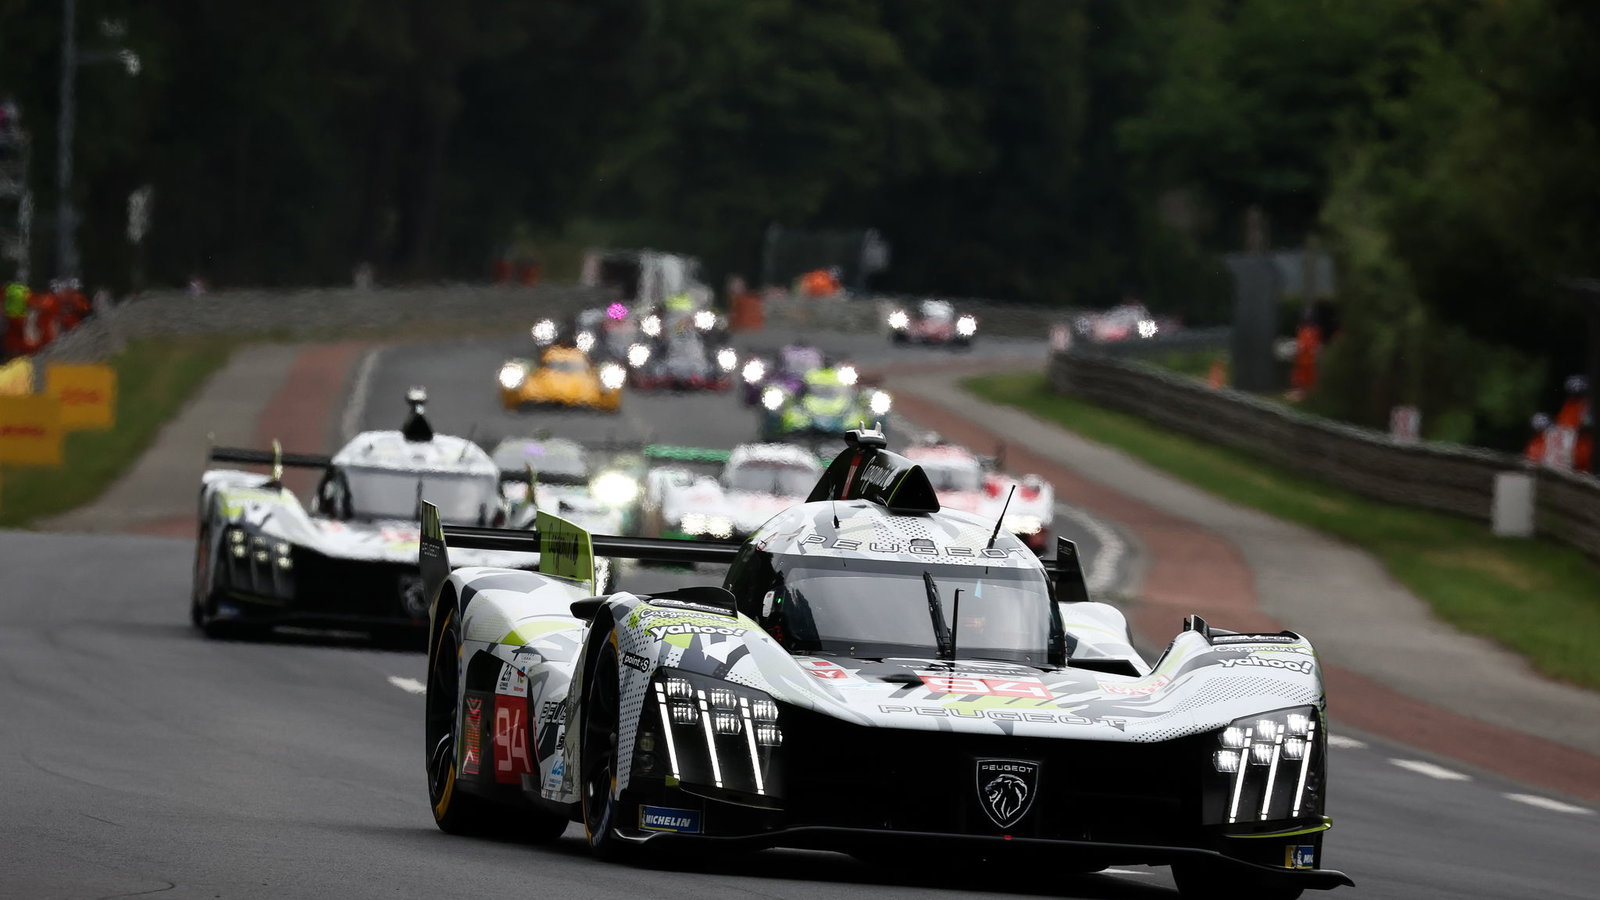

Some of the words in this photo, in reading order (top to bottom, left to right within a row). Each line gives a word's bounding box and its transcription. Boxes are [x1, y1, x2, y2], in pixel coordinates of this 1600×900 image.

[801, 534, 1028, 559] PEUGEOT
[640, 609, 721, 622] Capgemini
[650, 622, 748, 643] yahoo!
[1217, 655, 1314, 675] yahoo!
[928, 677, 1049, 699] 94
[878, 704, 1127, 731] PEUGEOT
[495, 706, 532, 773] 94
[981, 764, 1034, 774] PEUGEOT
[645, 813, 692, 828] MICHELIN
